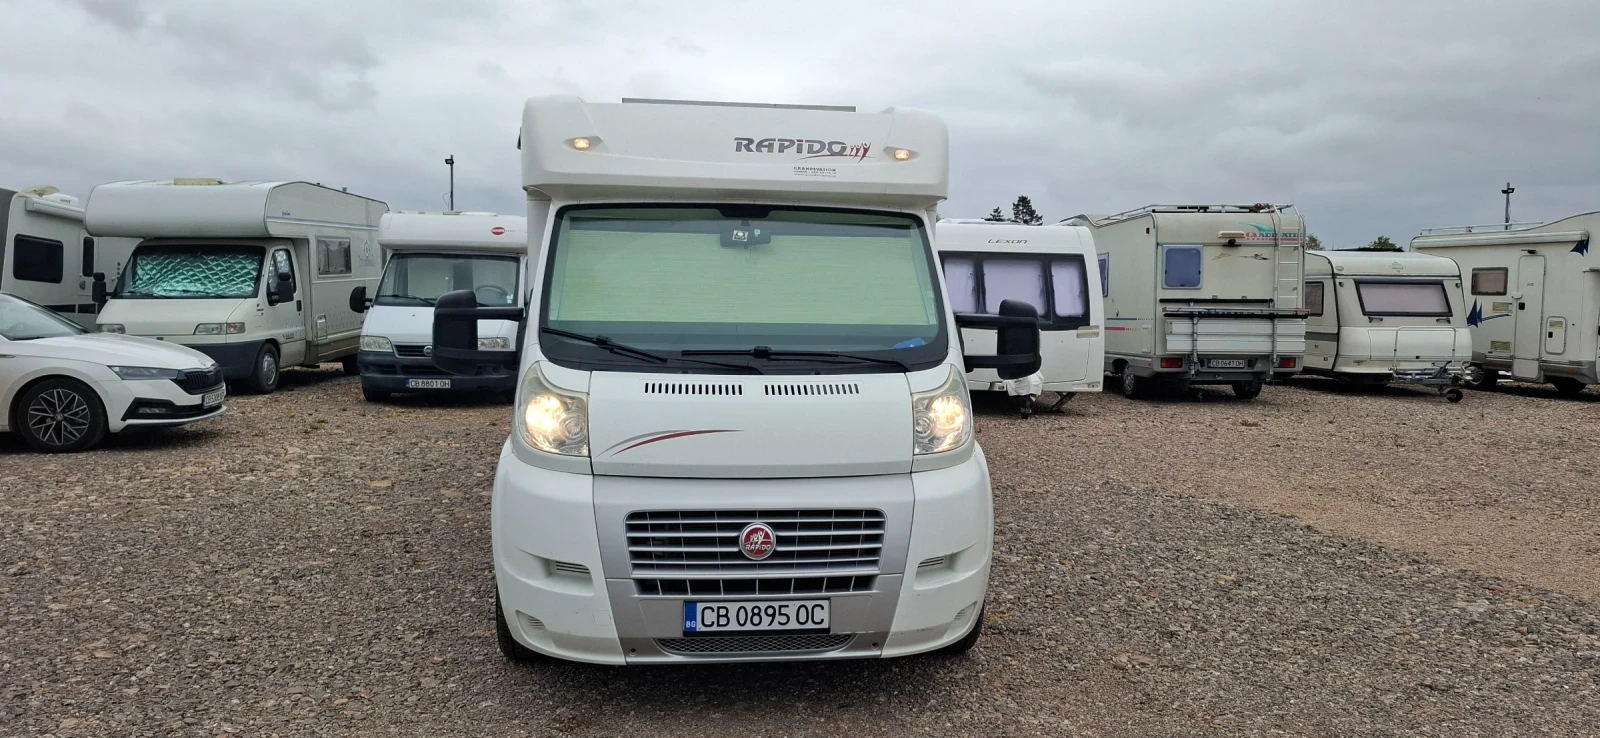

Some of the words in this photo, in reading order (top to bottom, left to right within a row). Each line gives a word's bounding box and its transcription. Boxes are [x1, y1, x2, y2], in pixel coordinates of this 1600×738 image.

[734, 137, 848, 156] RAPIDO
[410, 379, 420, 387] CB
[421, 380, 438, 388] 8801
[440, 380, 450, 388] OH
[701, 605, 731, 628] CB
[735, 604, 791, 627] 0895
[796, 603, 825, 626] OC
[685, 620, 697, 628] BG
